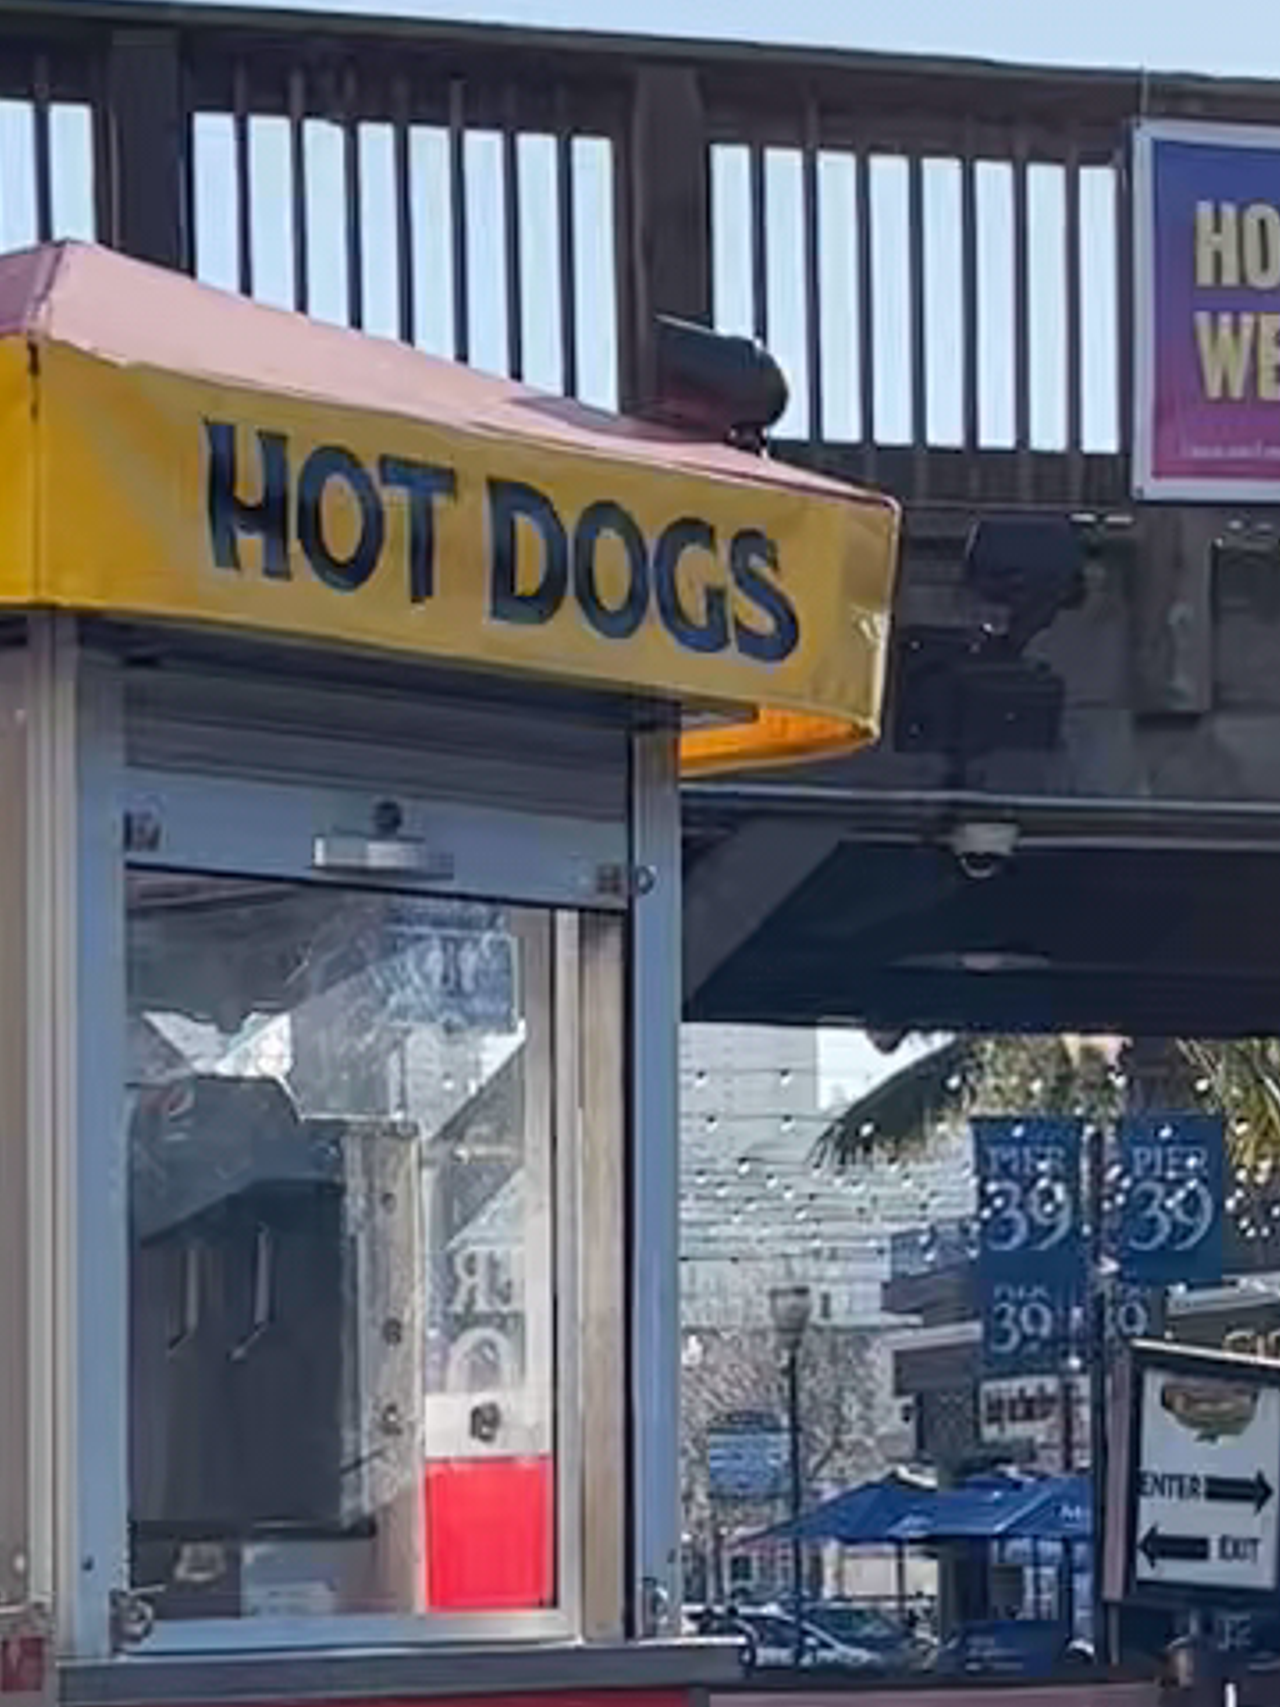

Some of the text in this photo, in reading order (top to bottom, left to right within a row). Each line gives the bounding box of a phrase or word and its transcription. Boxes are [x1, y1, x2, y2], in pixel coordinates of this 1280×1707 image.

[201, 416, 802, 664] HOT DOGS
[985, 1145, 1067, 1177] PIER
[1131, 1146, 1210, 1177] PIER
[983, 1180, 1071, 1252] 39
[1128, 1180, 1214, 1252] 39
[990, 1302, 1053, 1352] 39
[1136, 1472, 1202, 1501] ENTER
[1220, 1536, 1261, 1564] EXIT
